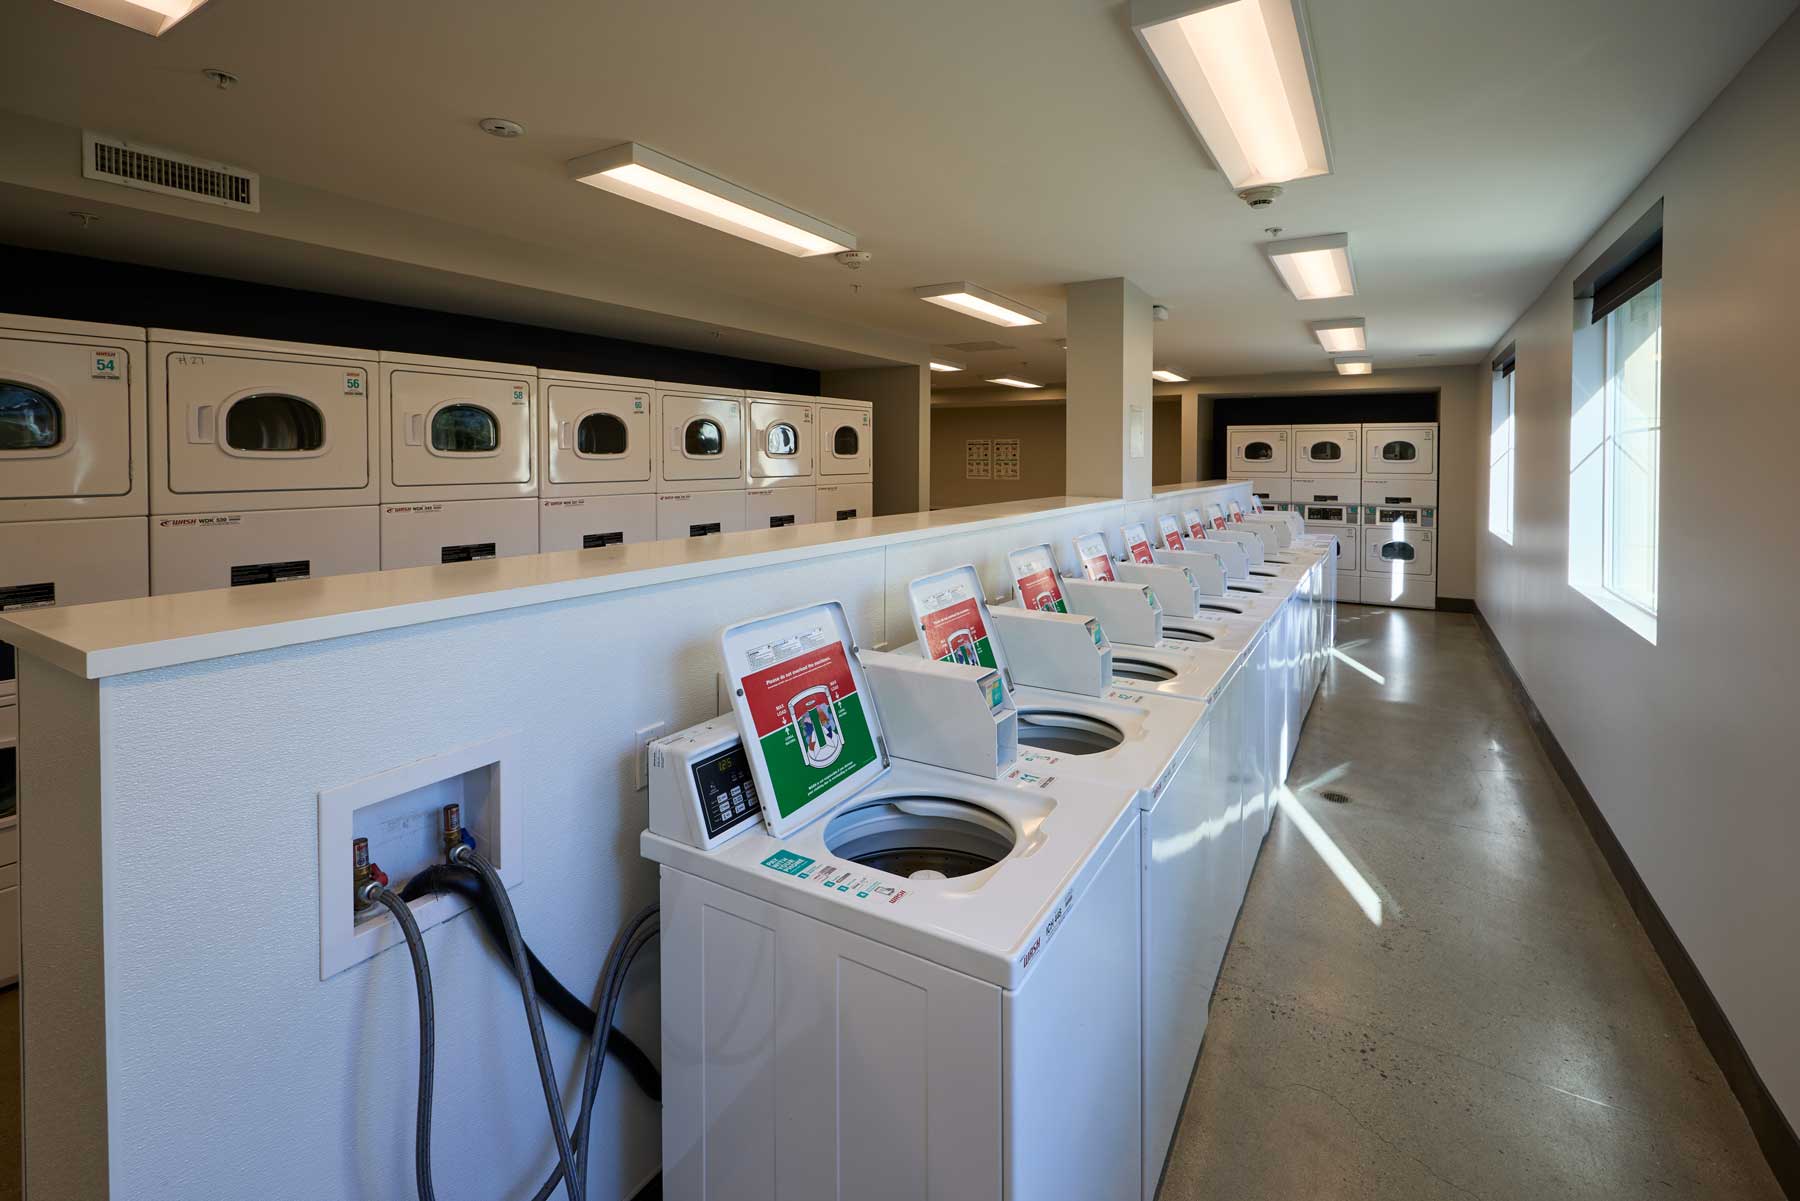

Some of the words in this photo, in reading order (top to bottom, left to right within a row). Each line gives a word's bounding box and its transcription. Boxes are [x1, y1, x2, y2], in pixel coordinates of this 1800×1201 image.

[96, 358, 115, 371] 54
[346, 378, 360, 389] 56
[513, 391, 523, 400] 58
[172, 518, 197, 527] WASH
[776, 709, 787, 717] LOAD
